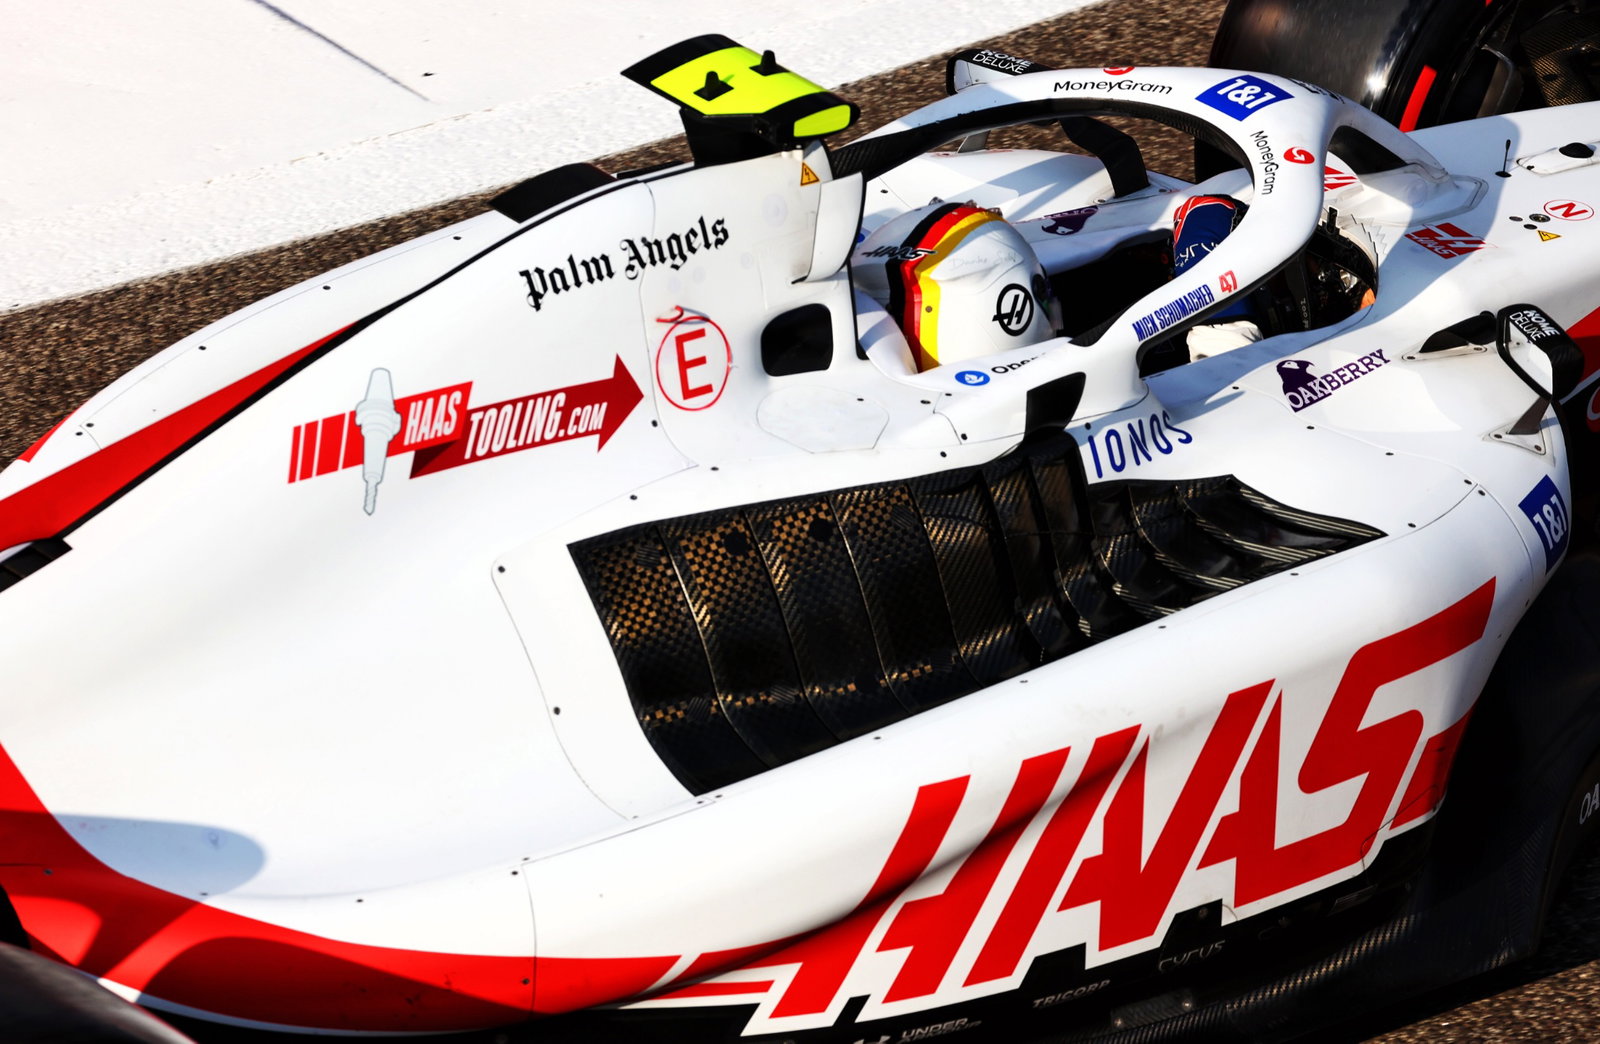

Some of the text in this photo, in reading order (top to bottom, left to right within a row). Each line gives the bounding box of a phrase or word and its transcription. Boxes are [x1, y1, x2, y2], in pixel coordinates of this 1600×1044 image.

[973, 53, 1027, 74] DELUXE
[1053, 79, 1173, 95] MoneyGram
[1216, 78, 1277, 109] 1&1
[1250, 130, 1280, 195] MoneyGram
[519, 215, 730, 312] Palm Angels
[1132, 270, 1238, 342] MICK SCHUMACHER 47
[1509, 311, 1546, 341] DELUXE
[1522, 310, 1560, 336] HOME
[674, 327, 715, 401] E
[1285, 348, 1391, 411] OAKBERRY
[404, 390, 463, 447] HAAS
[1087, 410, 1193, 479] IONOS
[1533, 493, 1567, 551] 1&1
[768, 575, 1497, 1020] HAAS
[1032, 978, 1112, 1009] TRICORP
[901, 1016, 969, 1038] UNDER
